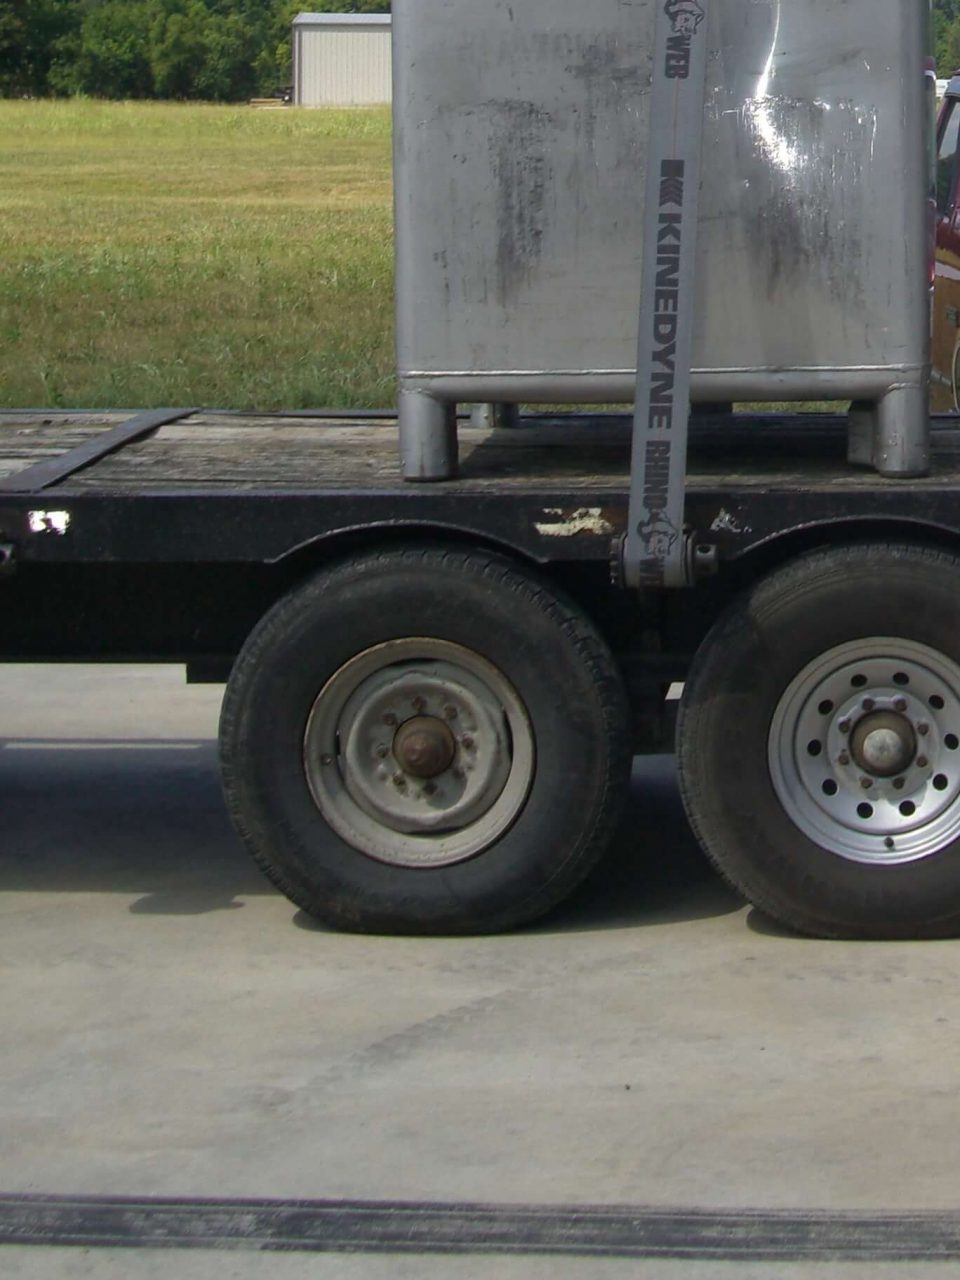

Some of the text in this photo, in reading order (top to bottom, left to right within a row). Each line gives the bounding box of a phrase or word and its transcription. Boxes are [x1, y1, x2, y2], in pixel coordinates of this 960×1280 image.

[664, 35, 692, 80] WEB
[648, 212, 682, 430] KINEDYNE
[643, 440, 672, 510] RHINO
